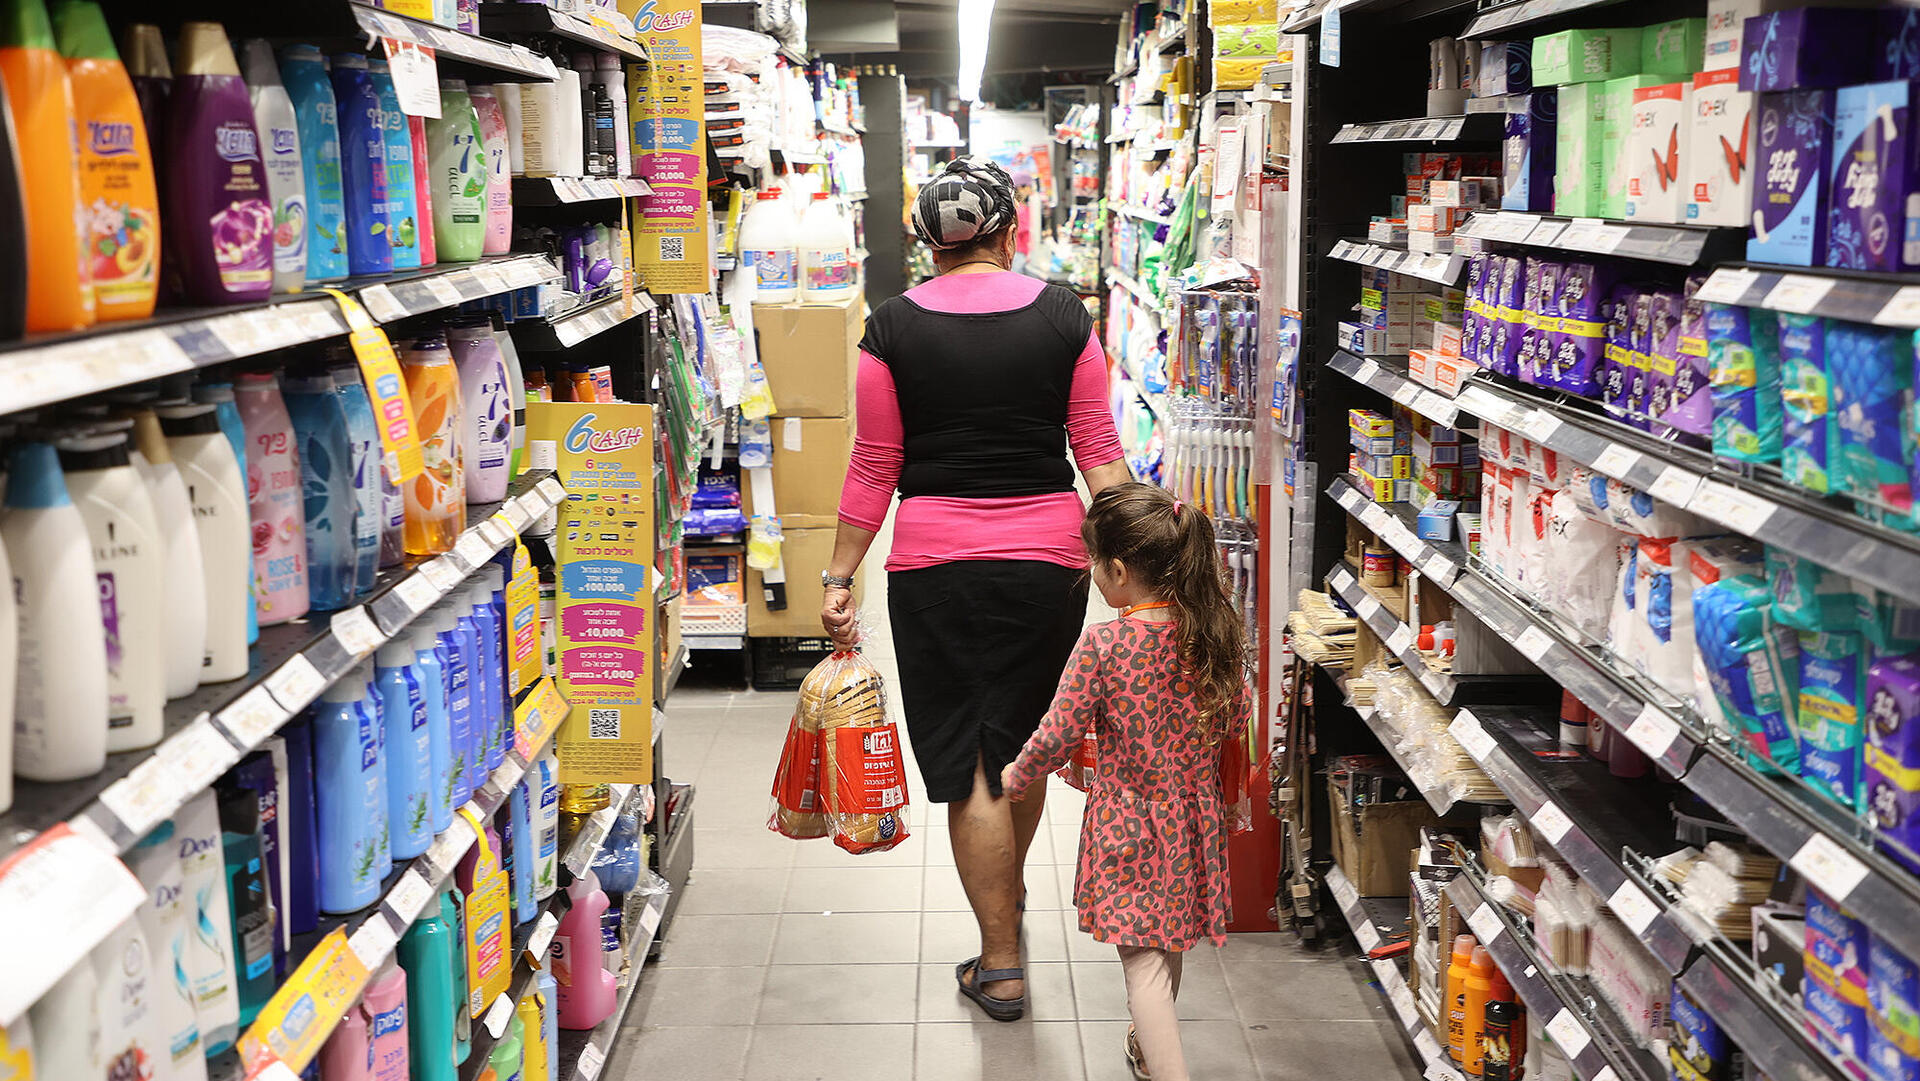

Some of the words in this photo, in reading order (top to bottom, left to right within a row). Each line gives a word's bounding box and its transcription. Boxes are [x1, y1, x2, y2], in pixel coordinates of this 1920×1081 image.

[634, 1, 659, 33] 6
[652, 10, 694, 31] CASH
[649, 37, 656, 45] 6
[654, 172, 685, 180] 10,000
[564, 413, 596, 454] 6
[589, 426, 644, 452] CASH
[257, 432, 287, 456] כיף
[585, 458, 594, 469] 6
[583, 582, 625, 592] 100,000
[585, 628, 624, 638] 10,000
[601, 669, 634, 679] 1,000
